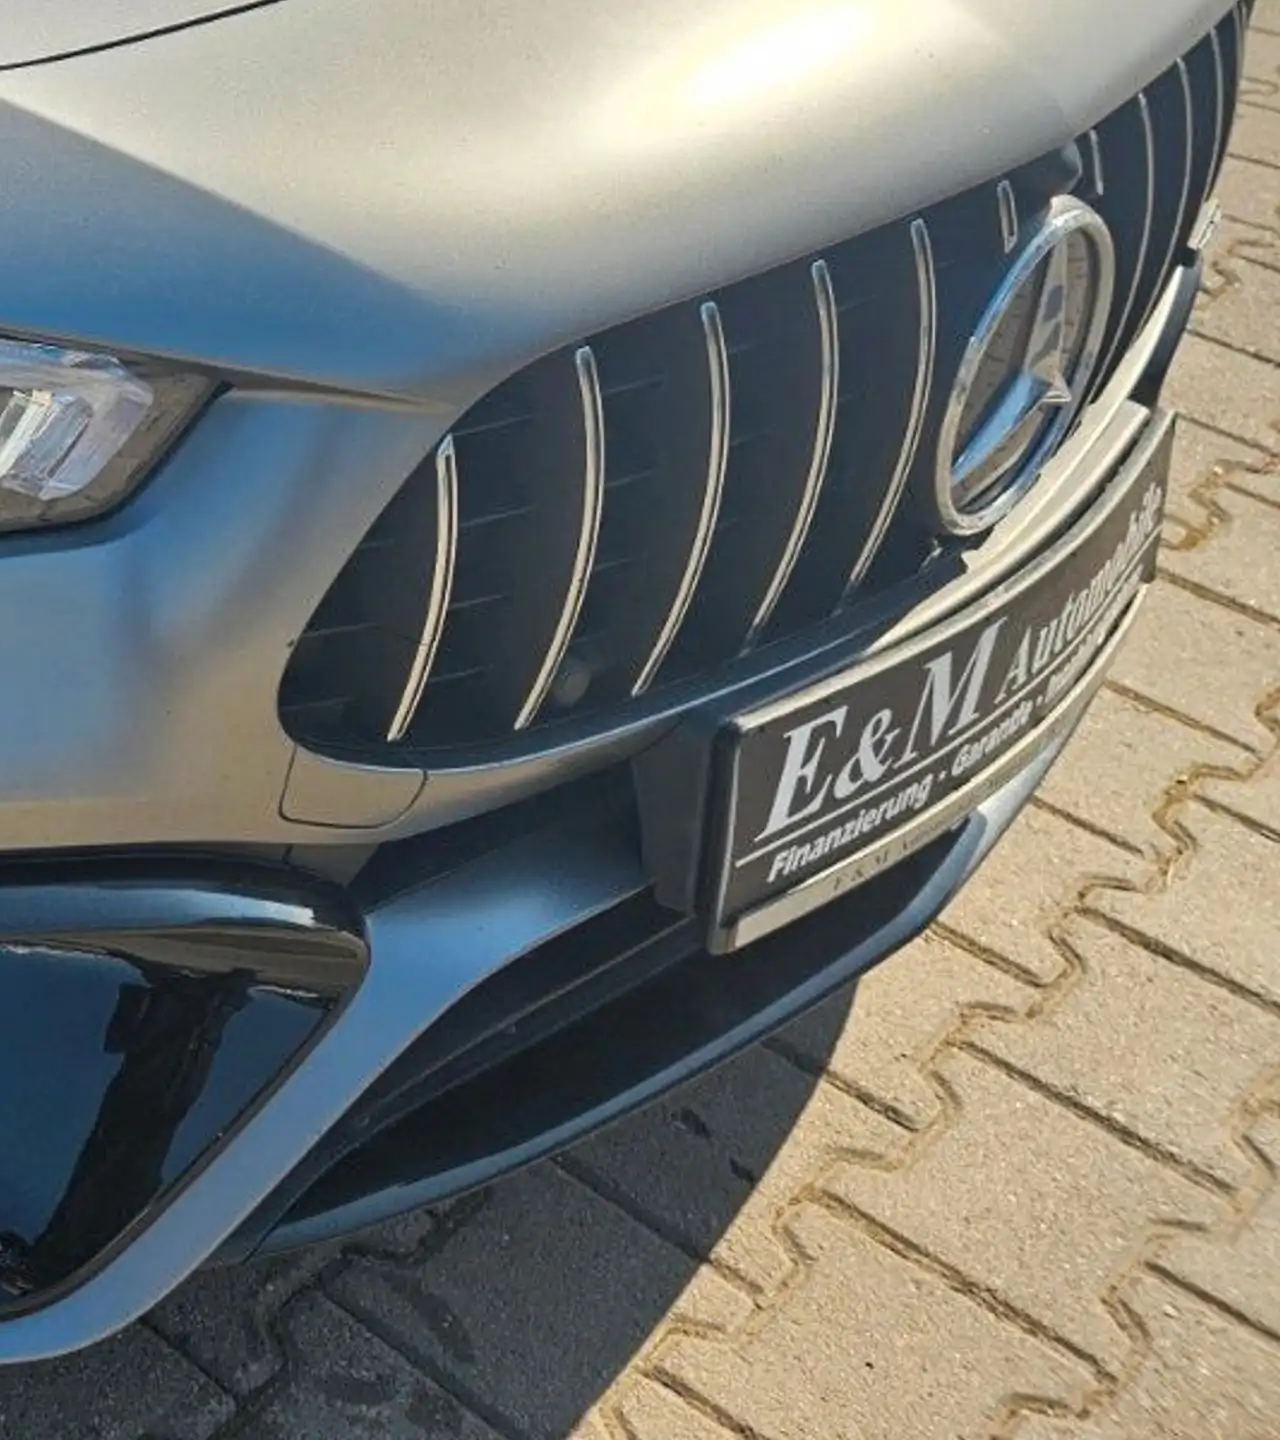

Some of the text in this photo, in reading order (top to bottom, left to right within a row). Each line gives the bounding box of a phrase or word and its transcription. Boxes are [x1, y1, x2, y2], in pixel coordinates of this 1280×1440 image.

[993, 481, 1163, 705] Automobile
[766, 772, 935, 883] Finanzierung
[951, 698, 1034, 778] Garantie
